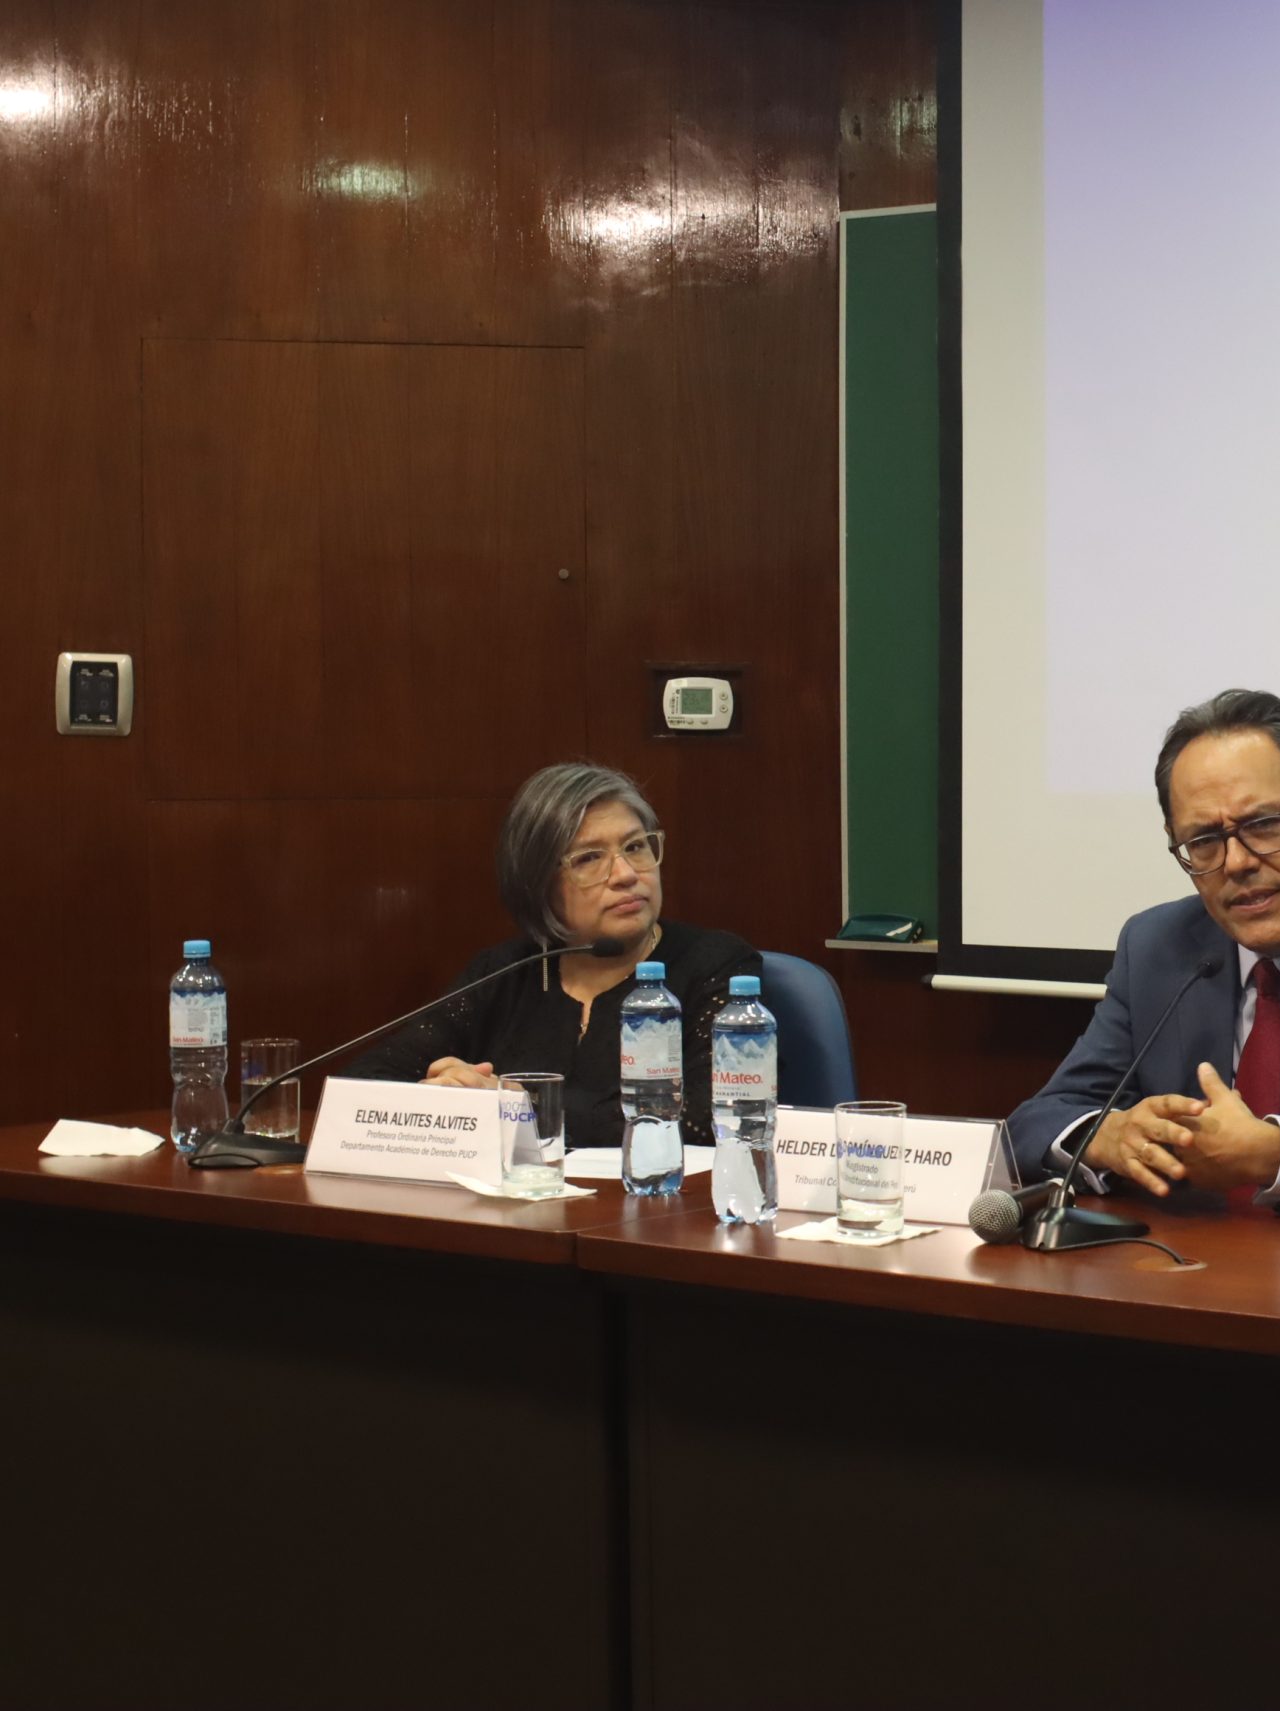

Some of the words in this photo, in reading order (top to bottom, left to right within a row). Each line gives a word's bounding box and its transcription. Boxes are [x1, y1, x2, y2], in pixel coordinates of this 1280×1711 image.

[355, 1109, 388, 1125] ELENA
[390, 1112, 431, 1128] ALVITES
[433, 1115, 478, 1132] ALVITES
[503, 1111, 537, 1123] PUCP
[366, 1130, 397, 1141] Profesora
[427, 1134, 457, 1145] Principal
[340, 1140, 384, 1152] Departamento
[421, 1145, 430, 1155] de
[430, 1146, 458, 1158] Derecho
[458, 1148, 478, 1159] PUCP
[776, 1139, 828, 1157] HELDER
[913, 1149, 953, 1167] HARO
[795, 1175, 826, 1186] Tribunal
